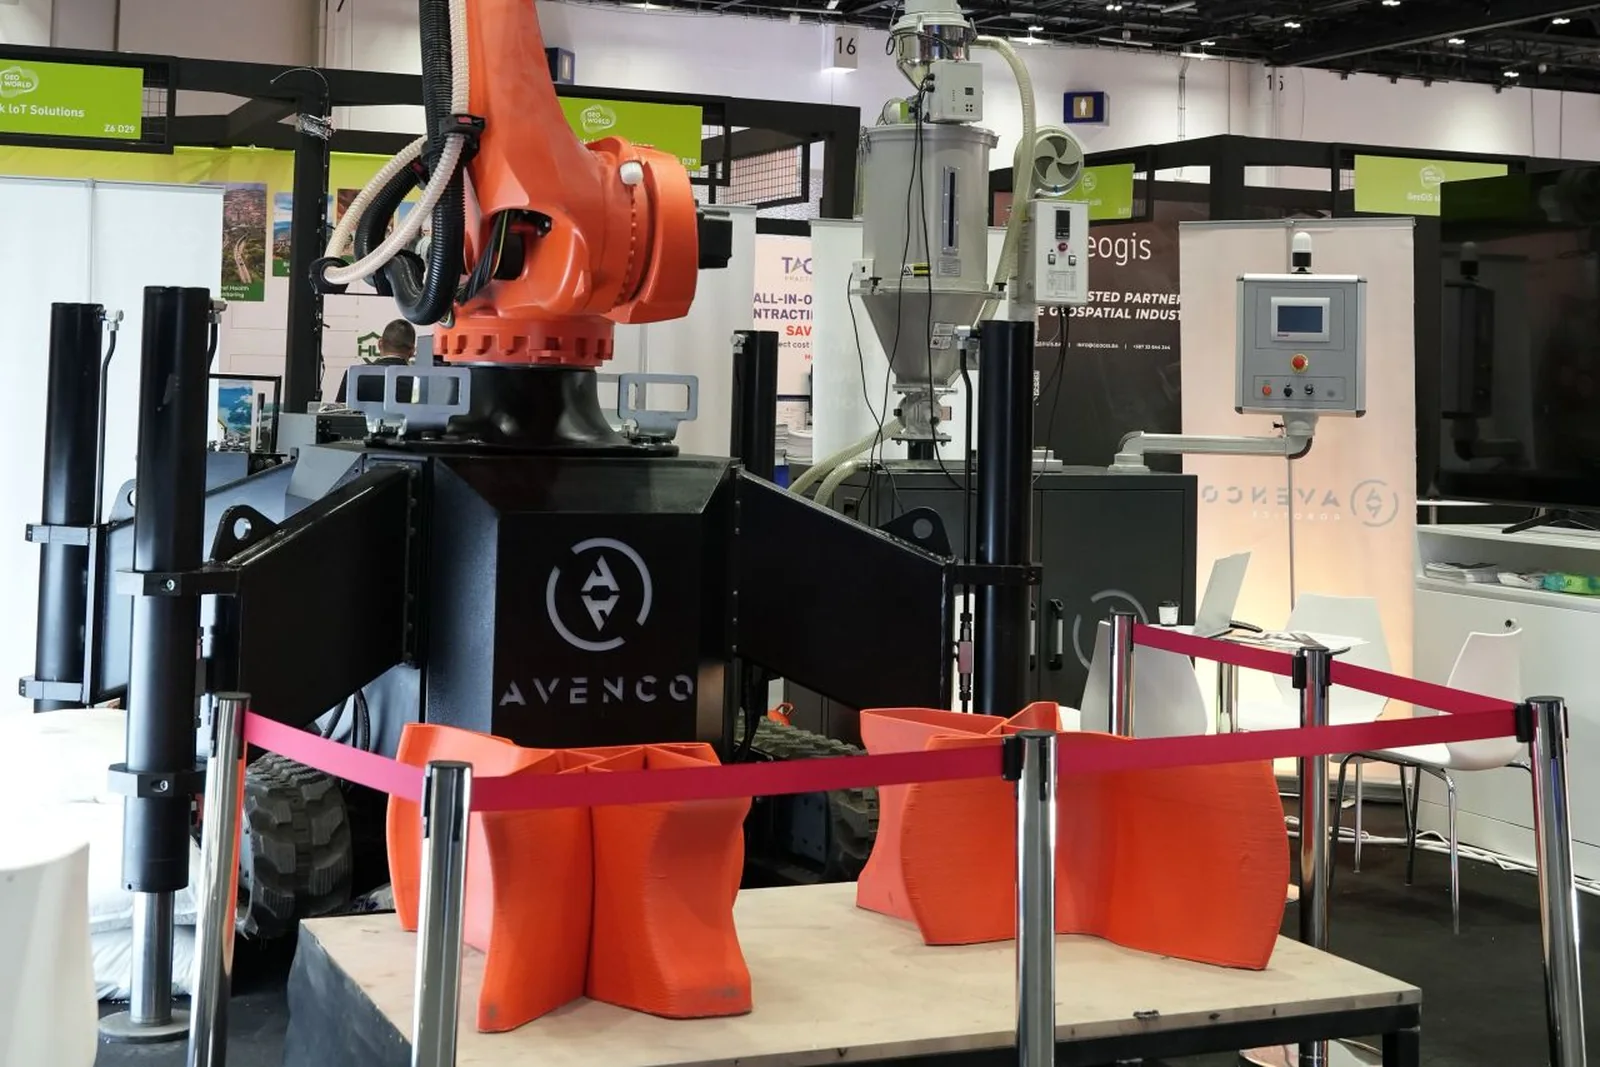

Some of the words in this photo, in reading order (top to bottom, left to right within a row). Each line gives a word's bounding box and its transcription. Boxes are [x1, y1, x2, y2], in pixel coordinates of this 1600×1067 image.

[836, 36, 856, 55] 16
[4, 73, 20, 81] GEO
[4, 80, 33, 89] WORLD
[30, 104, 85, 118] Solutions
[118, 124, 136, 134] D29
[1087, 291, 1121, 304] STED
[1049, 306, 1132, 320] GOSPATIAL
[792, 340, 810, 349] cost
[499, 674, 694, 706] AVENCO
